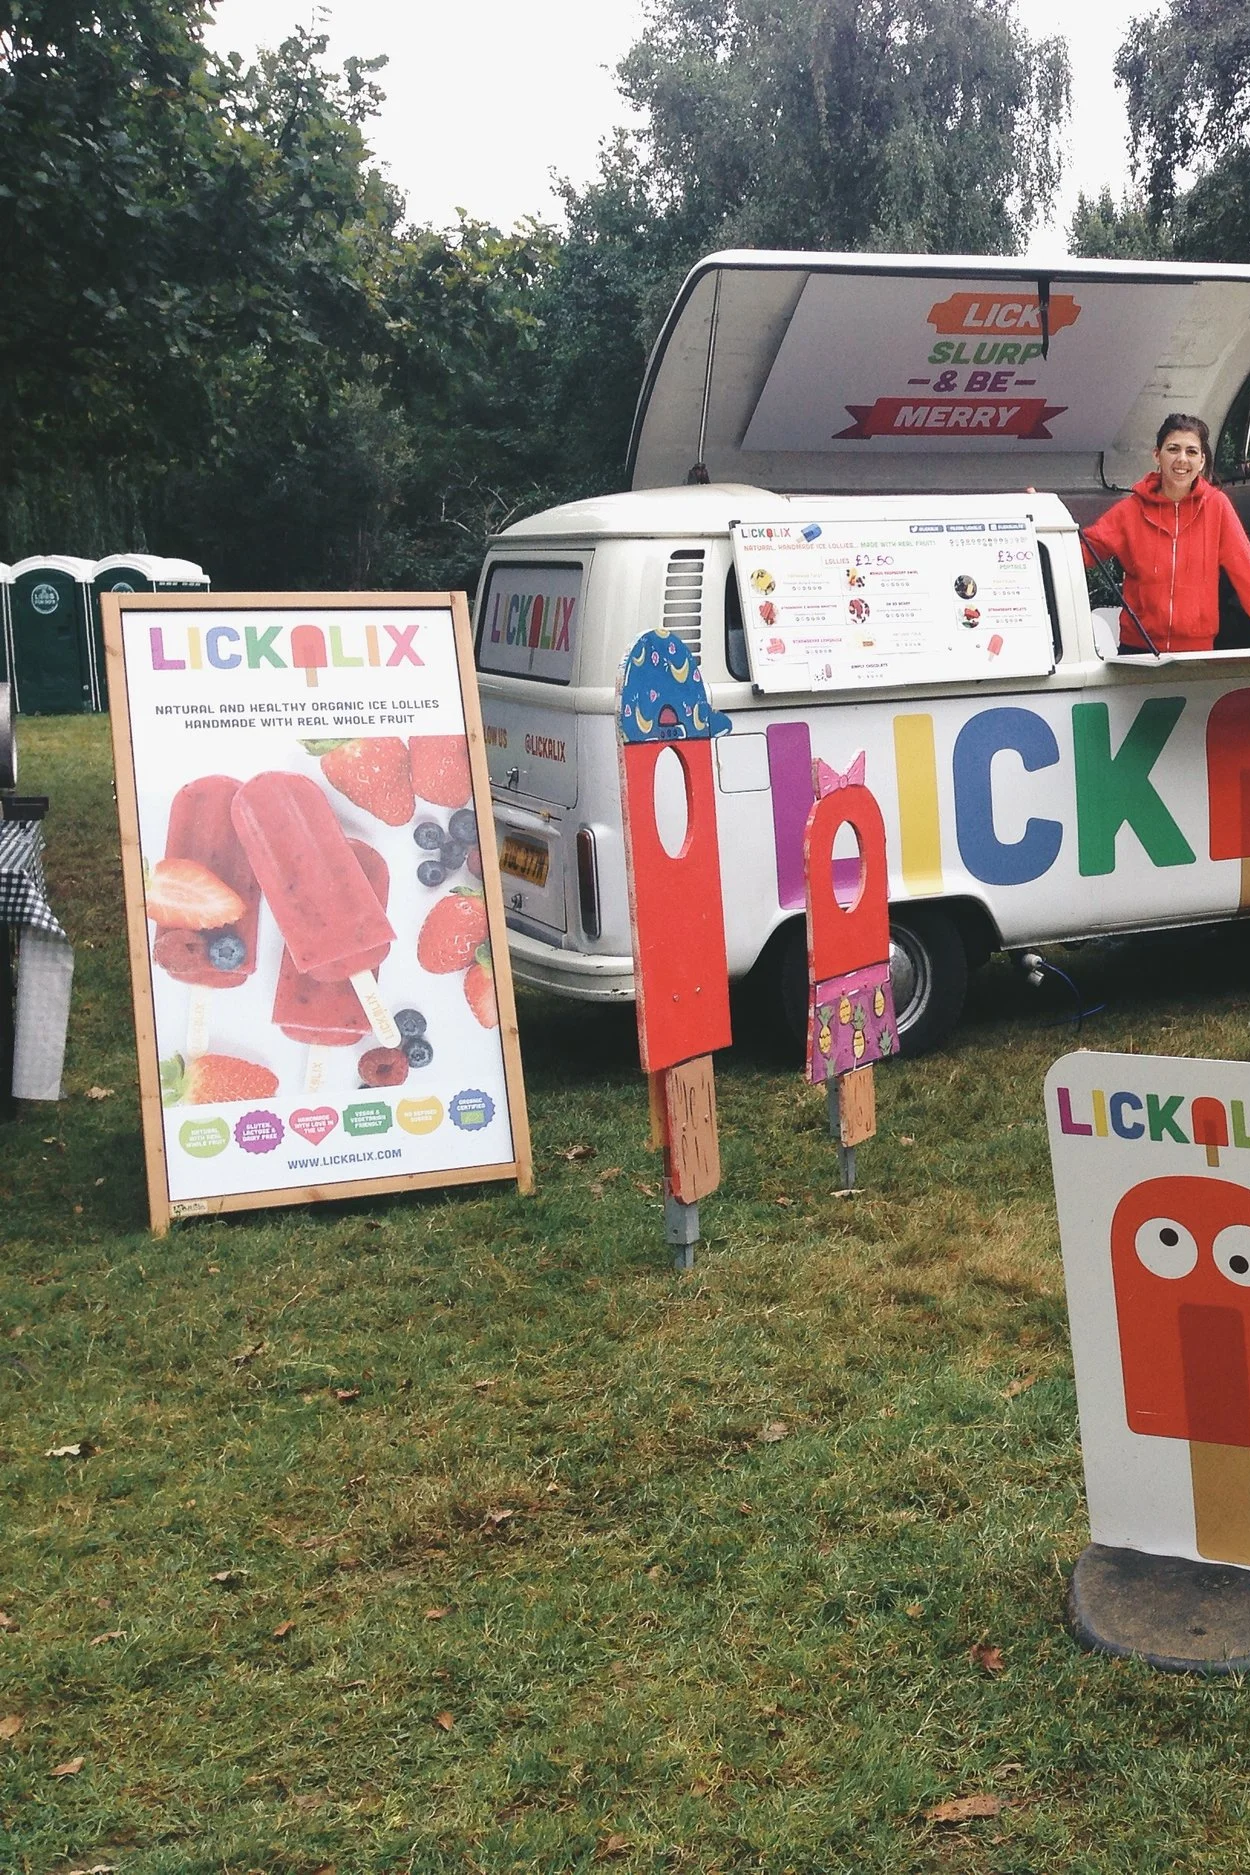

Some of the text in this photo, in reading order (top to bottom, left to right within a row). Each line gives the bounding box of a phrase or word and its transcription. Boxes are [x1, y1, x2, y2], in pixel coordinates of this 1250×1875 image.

[962, 303, 1042, 328] LICK
[927, 341, 1044, 365] SLURP
[964, 371, 1015, 393] BE
[893, 406, 1021, 428] MERRY
[155, 700, 439, 715] NATURAL AND HEALTHY ORGANIC ICE LOLLIES
[184, 714, 415, 729] HANDMADE WITH REAL WHOLE FRUIT
[287, 1149, 402, 1170] WWW.LICKALIX.COM
